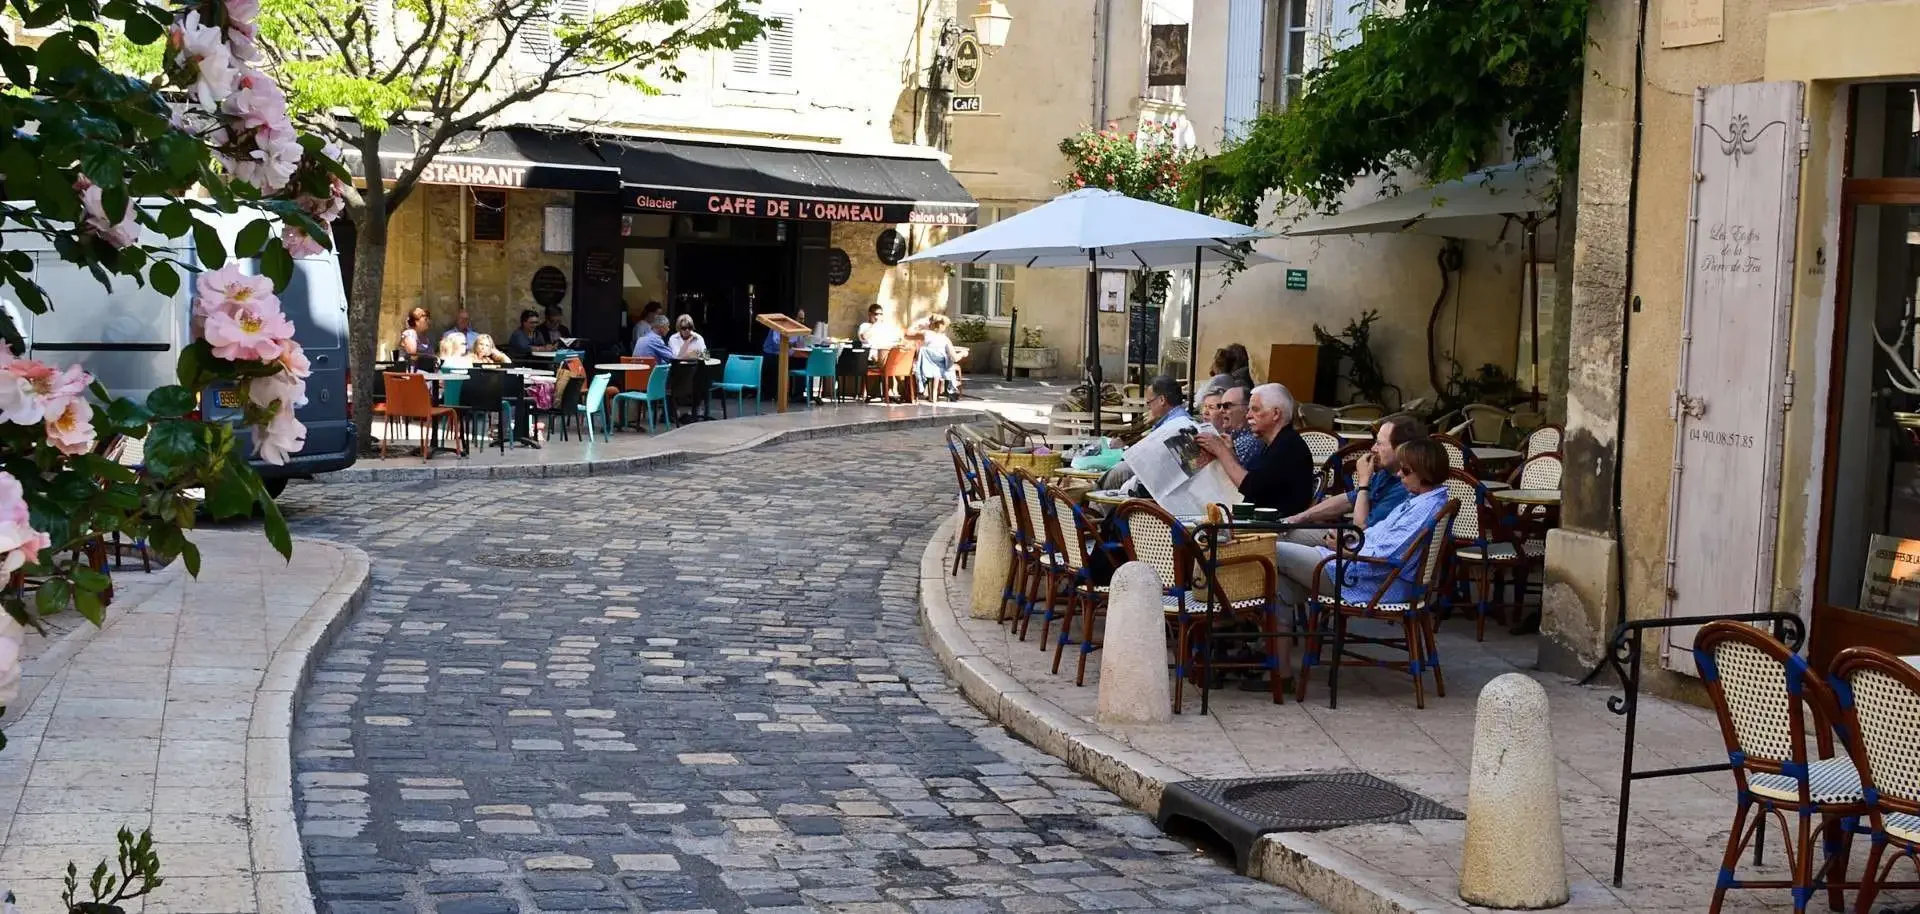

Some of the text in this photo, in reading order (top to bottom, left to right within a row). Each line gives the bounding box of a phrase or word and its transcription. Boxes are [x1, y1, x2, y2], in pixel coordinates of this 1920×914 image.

[953, 98, 979, 110] Café
[395, 160, 527, 186] RSTAURANT
[636, 195, 678, 209] Glacier
[707, 195, 756, 215] CAFE
[766, 199, 790, 217] DE
[908, 210, 968, 224] Salon de Thé
